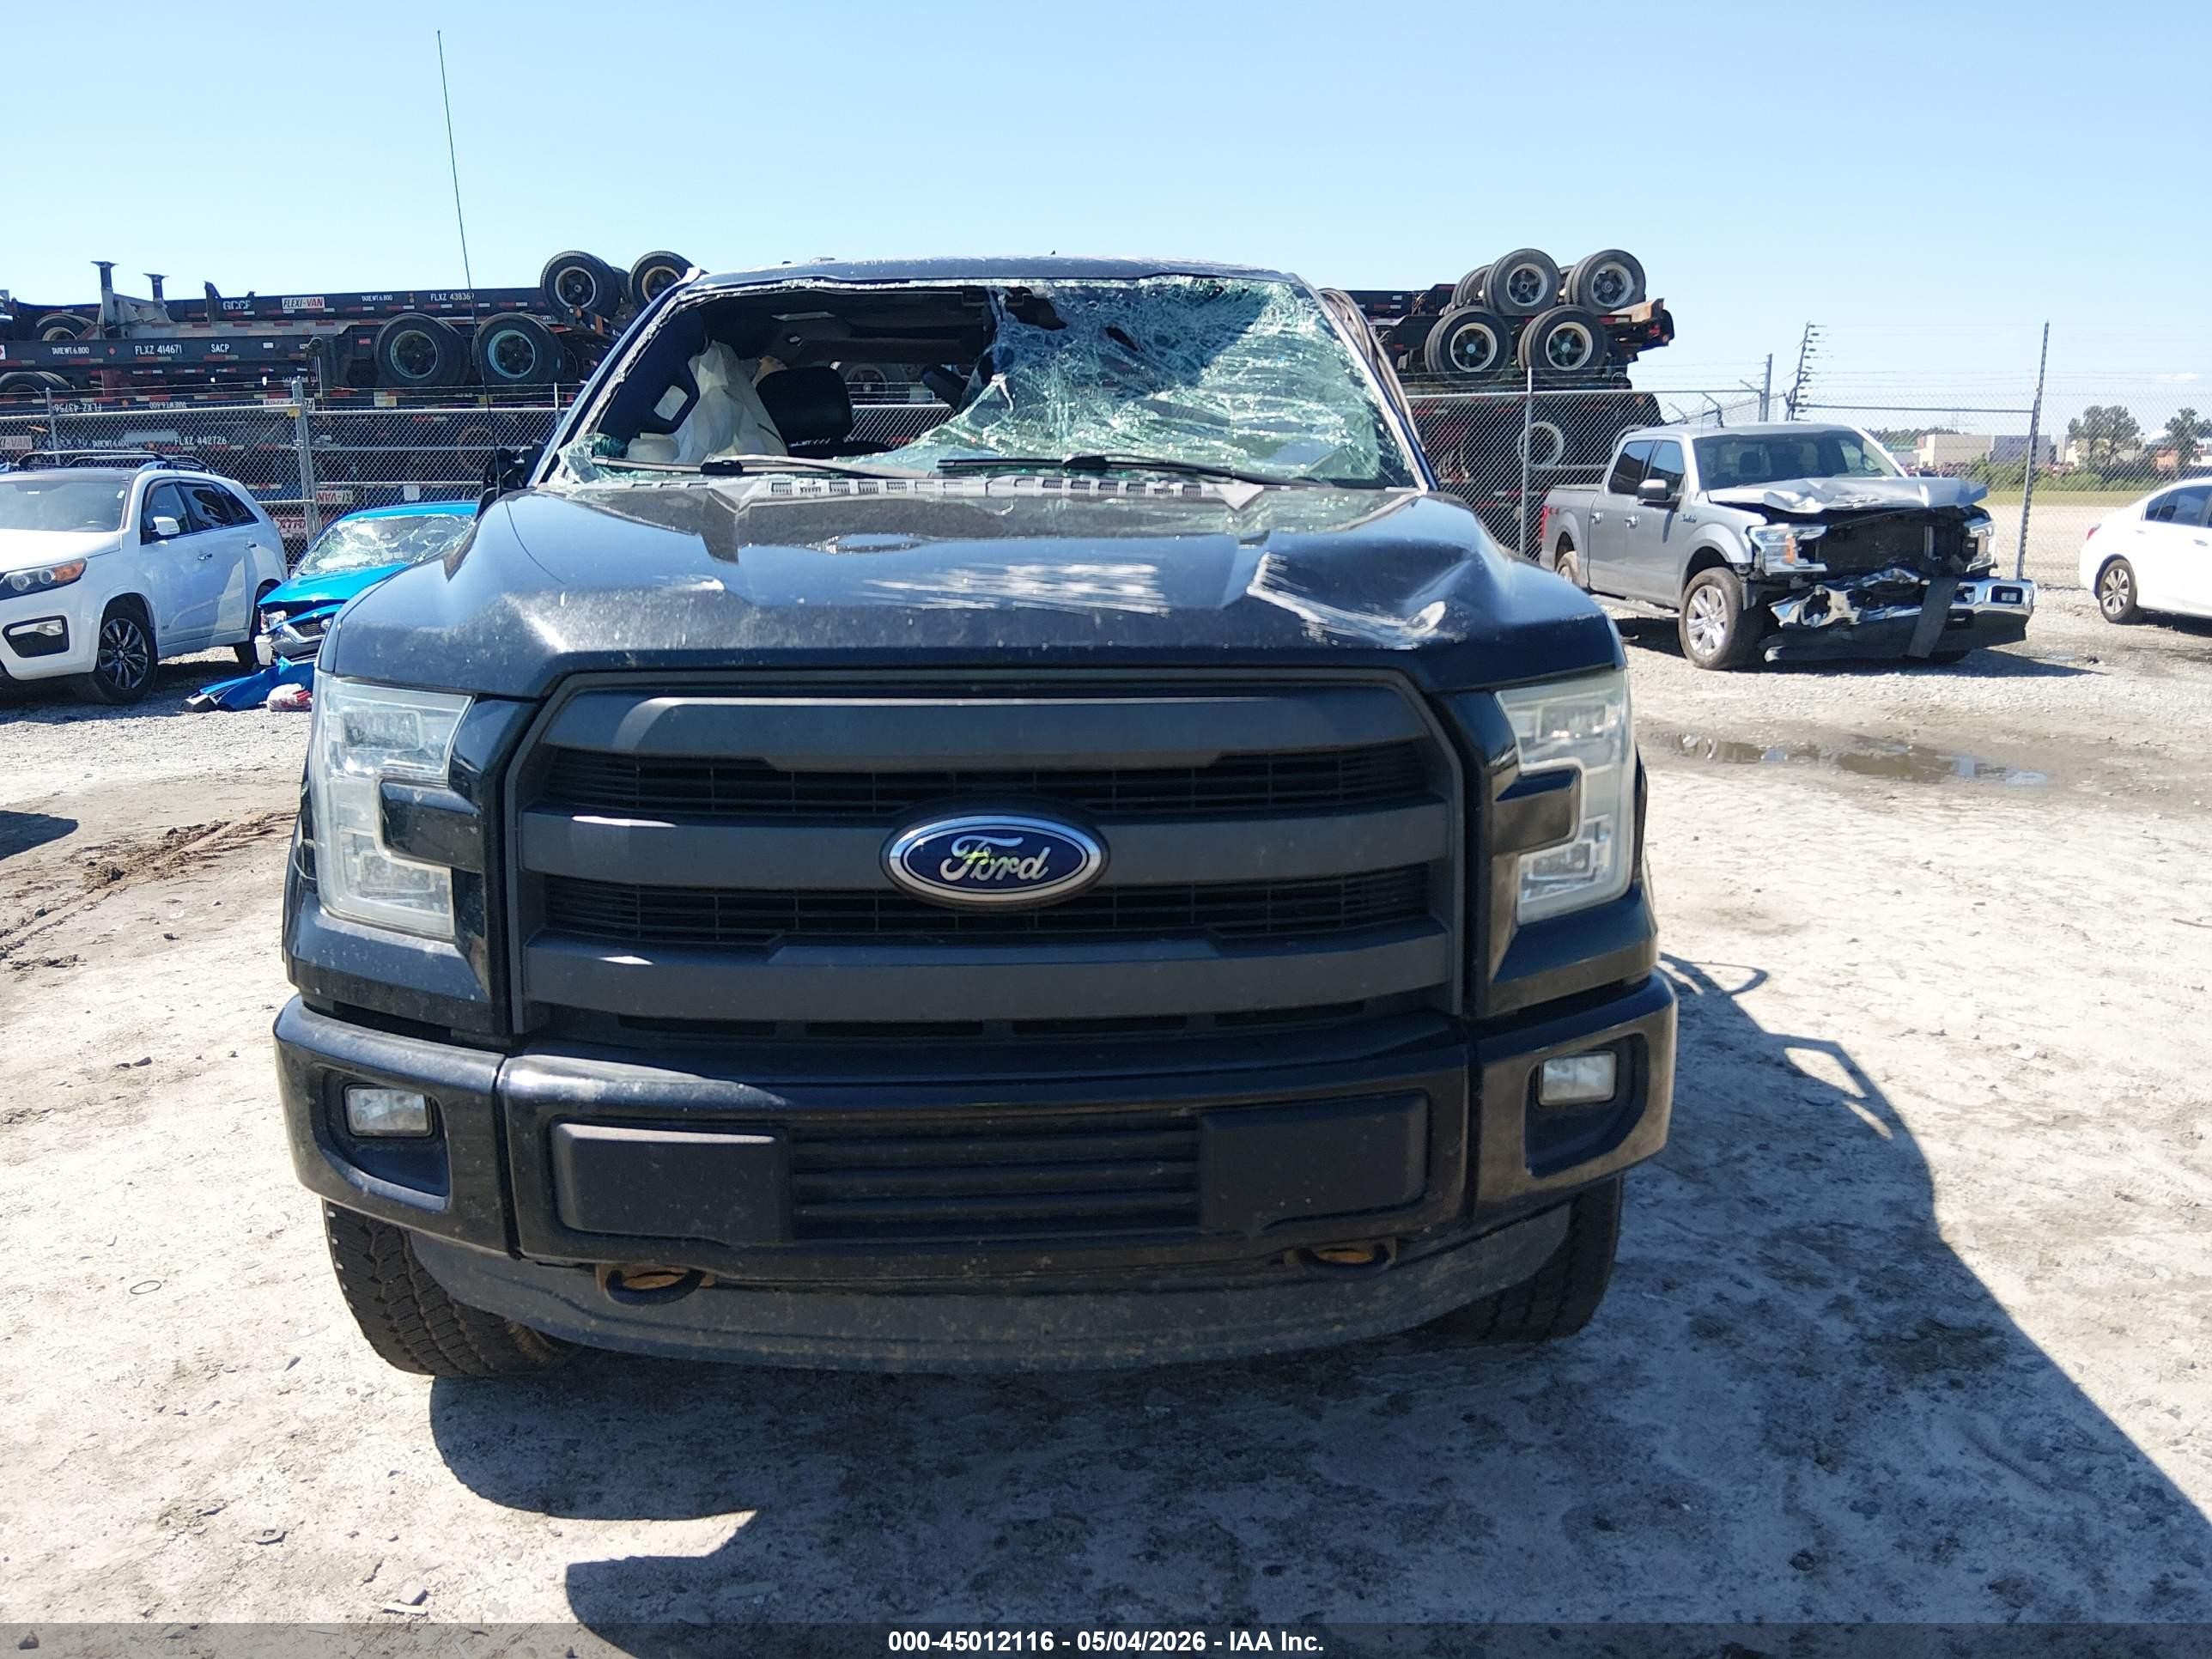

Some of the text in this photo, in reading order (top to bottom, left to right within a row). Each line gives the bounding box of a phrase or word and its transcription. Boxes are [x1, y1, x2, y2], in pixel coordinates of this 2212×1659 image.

[430, 293, 447, 301] FLXZ
[283, 298, 323, 308] FLEXI-VAN
[135, 344, 182, 355] FLXZ 414671
[211, 343, 229, 353] SACP
[174, 435, 227, 446] FLXZ 442726
[940, 835, 1051, 882] Ford
